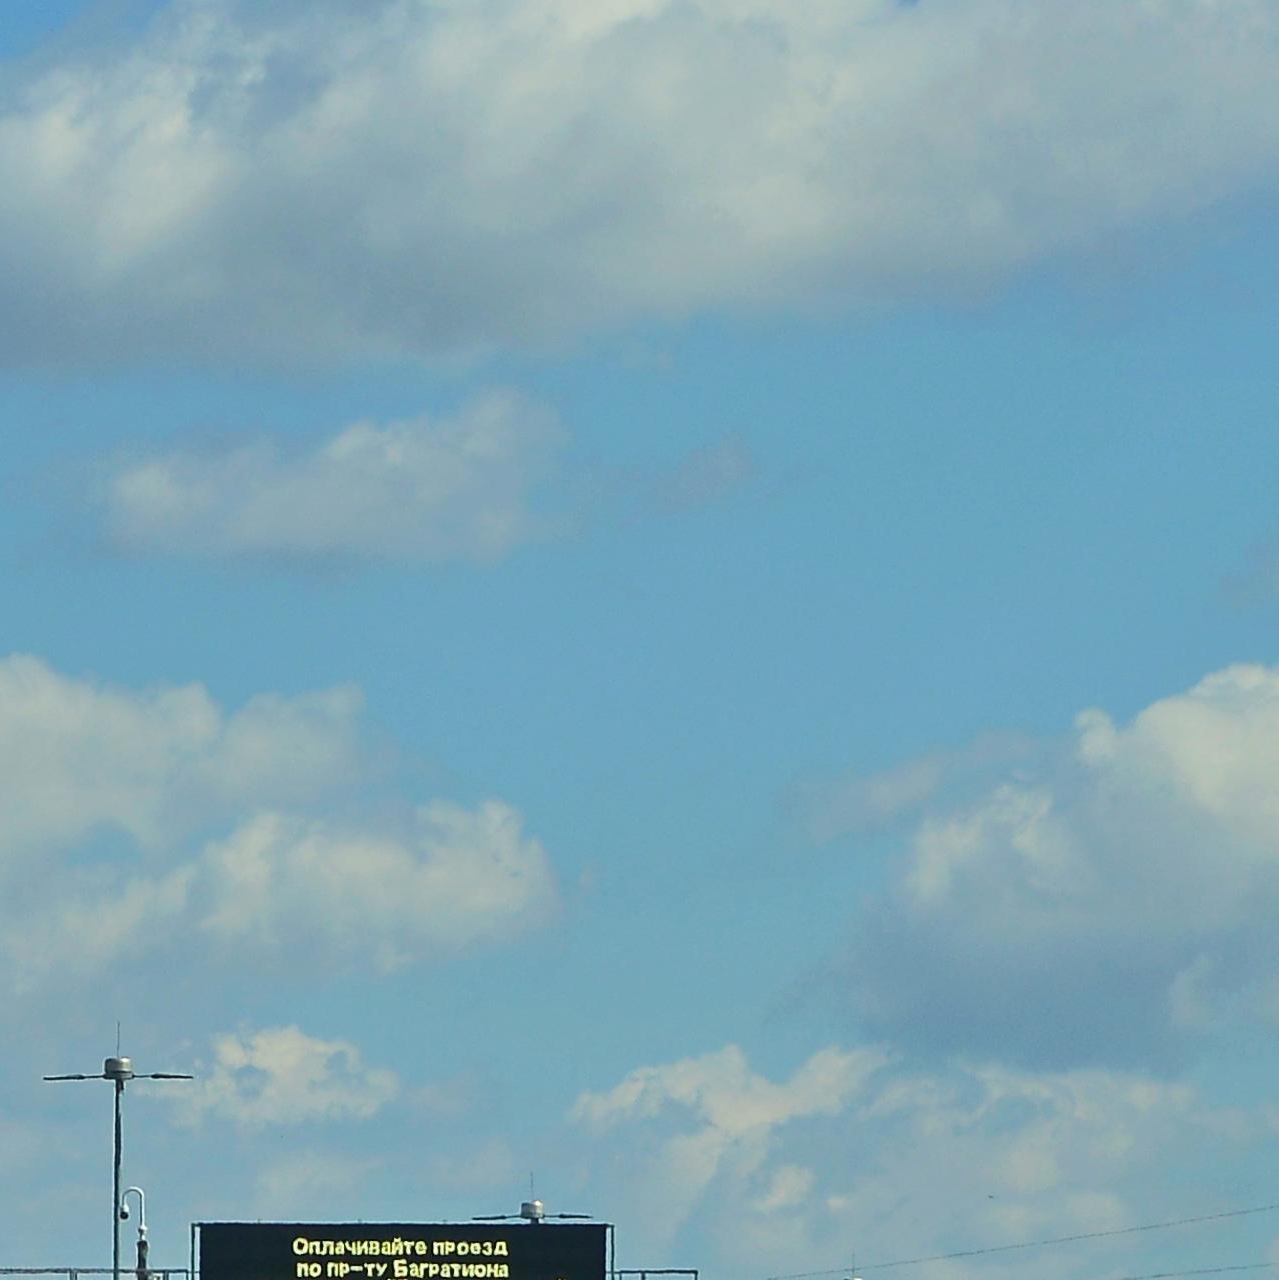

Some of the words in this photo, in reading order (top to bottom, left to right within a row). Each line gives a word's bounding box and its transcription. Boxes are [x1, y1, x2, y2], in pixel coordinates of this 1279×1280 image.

[292, 1237, 428, 1256] Оплачивайте
[433, 1240, 509, 1256] проезд
[296, 1262, 322, 1278] по
[327, 1261, 389, 1279] пр-ту
[393, 1259, 510, 1279] Багратиона
